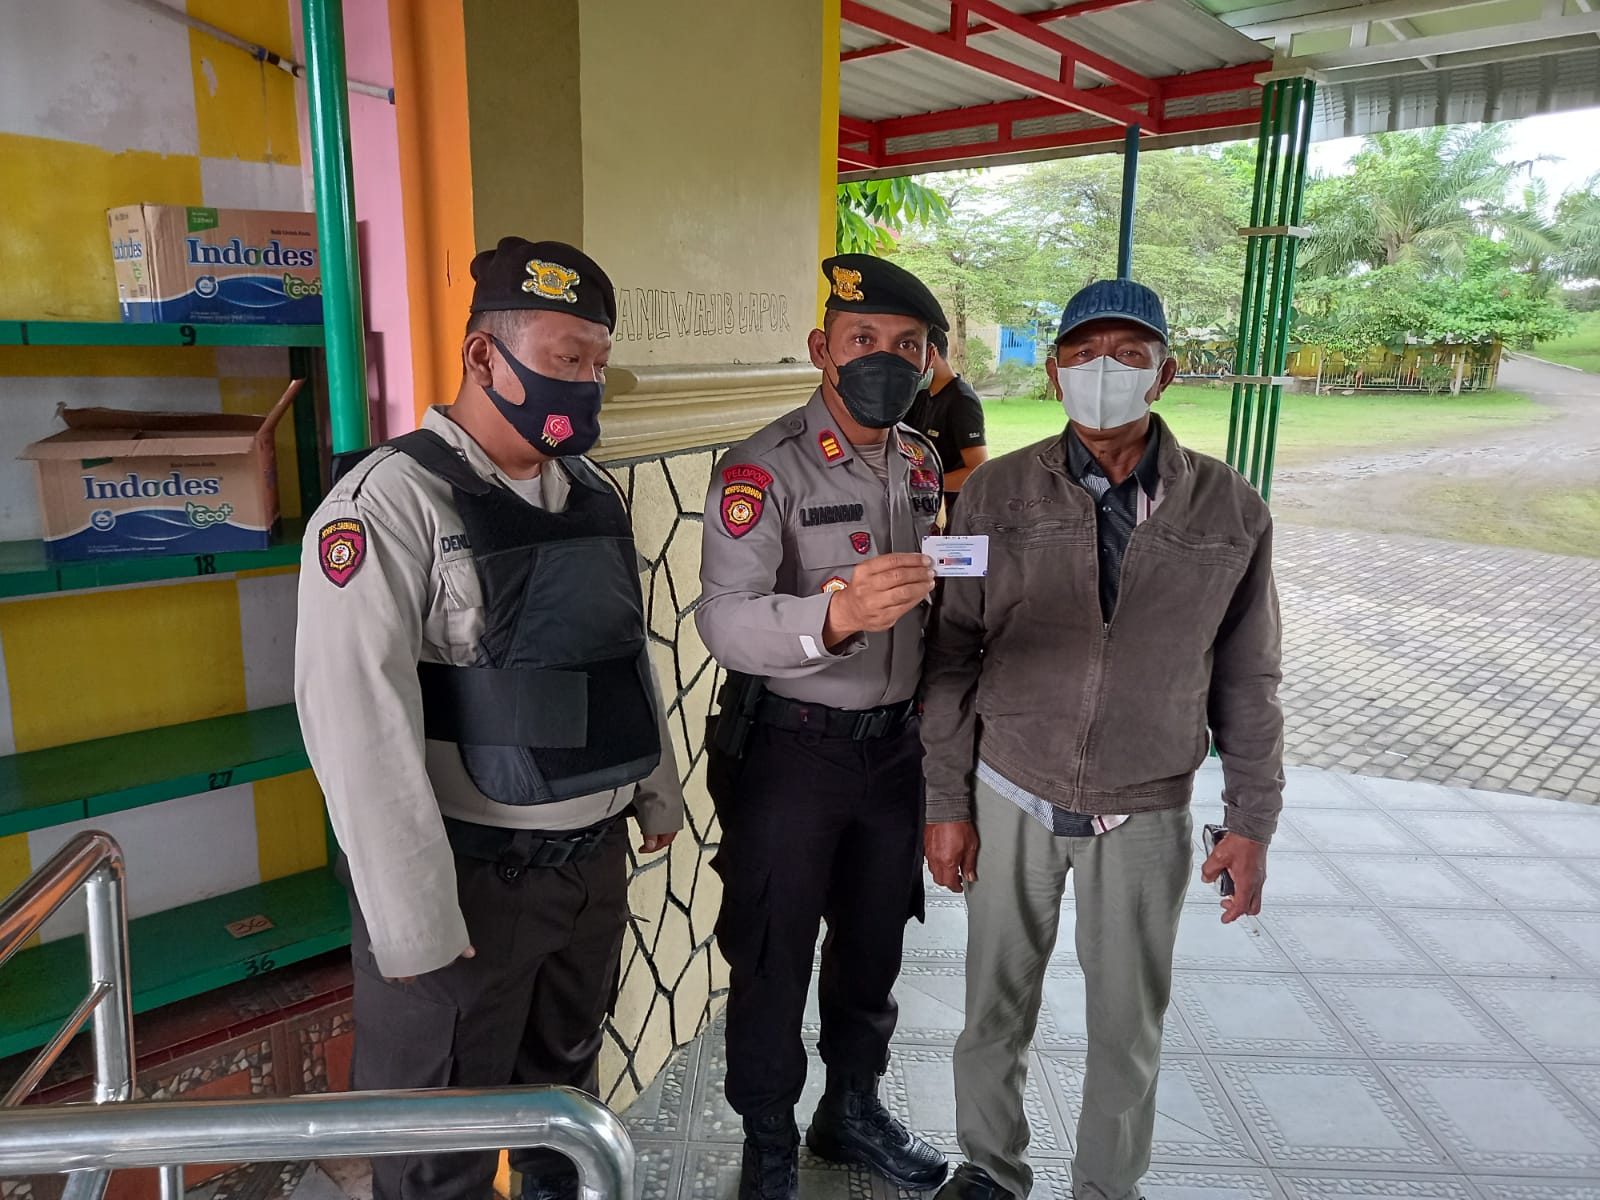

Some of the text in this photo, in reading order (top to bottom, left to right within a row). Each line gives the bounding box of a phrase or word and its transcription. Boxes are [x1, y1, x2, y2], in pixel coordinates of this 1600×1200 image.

[186, 236, 315, 267] Indodes
[738, 292, 791, 335] LAPOR
[179, 325, 197, 346] 9
[541, 432, 558, 448] TNI
[81, 472, 220, 500] Indodes
[727, 468, 768, 484] PELOPOR
[440, 534, 473, 554] DEN
[193, 554, 217, 576] 18
[207, 770, 234, 791] 27
[244, 954, 276, 975] 36
